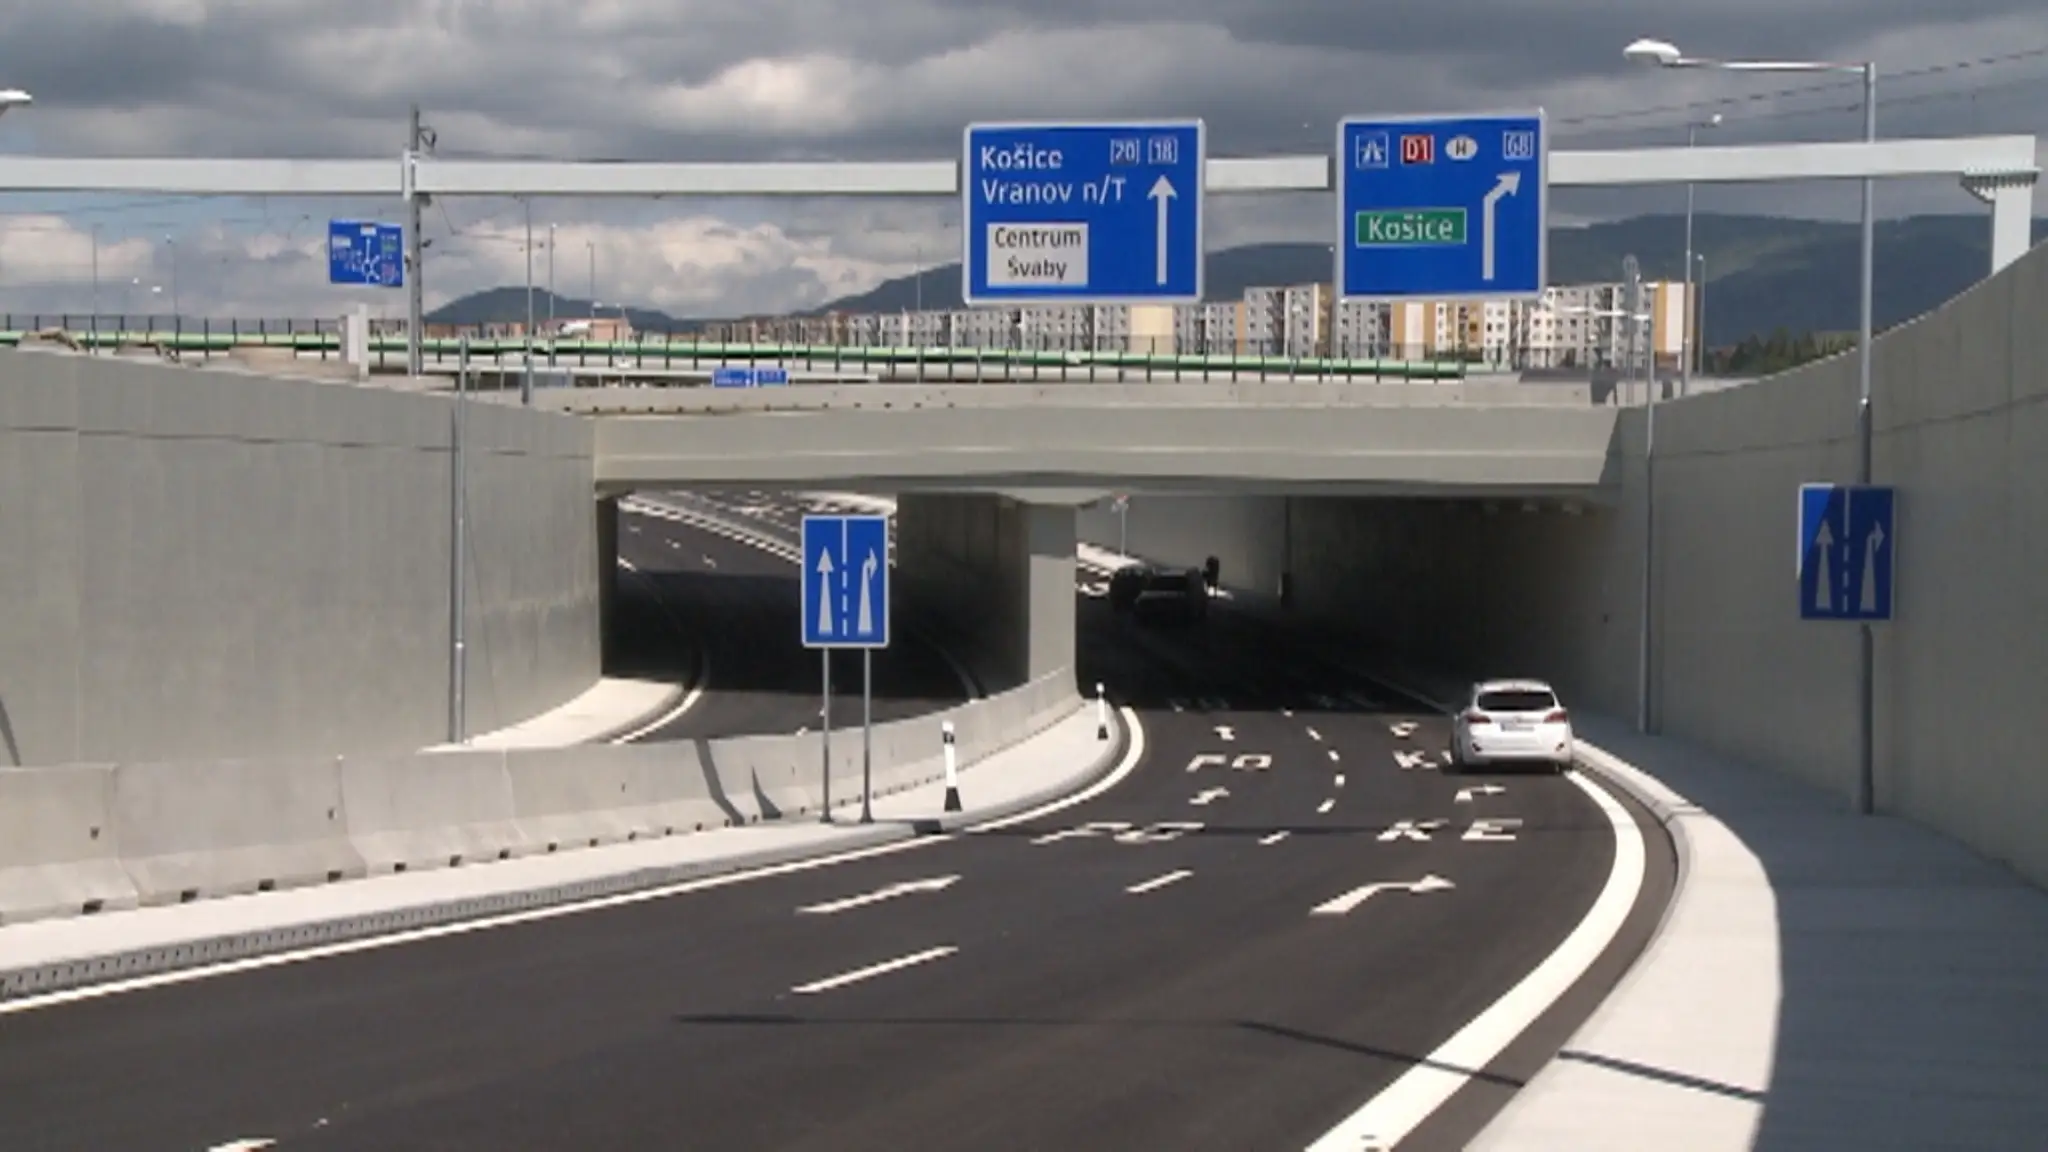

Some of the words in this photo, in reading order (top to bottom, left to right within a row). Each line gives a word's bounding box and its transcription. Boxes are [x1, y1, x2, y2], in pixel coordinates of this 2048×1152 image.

[980, 142, 1064, 170] Košice
[1114, 139, 1136, 162] 20
[1153, 139, 1174, 162] 18
[1405, 136, 1429, 161] D1
[981, 178, 1073, 205] Vranov
[1083, 174, 1127, 206] n/T
[994, 226, 1082, 250] Centrum
[1368, 212, 1454, 242] Košice
[1376, 817, 1523, 841] KE
